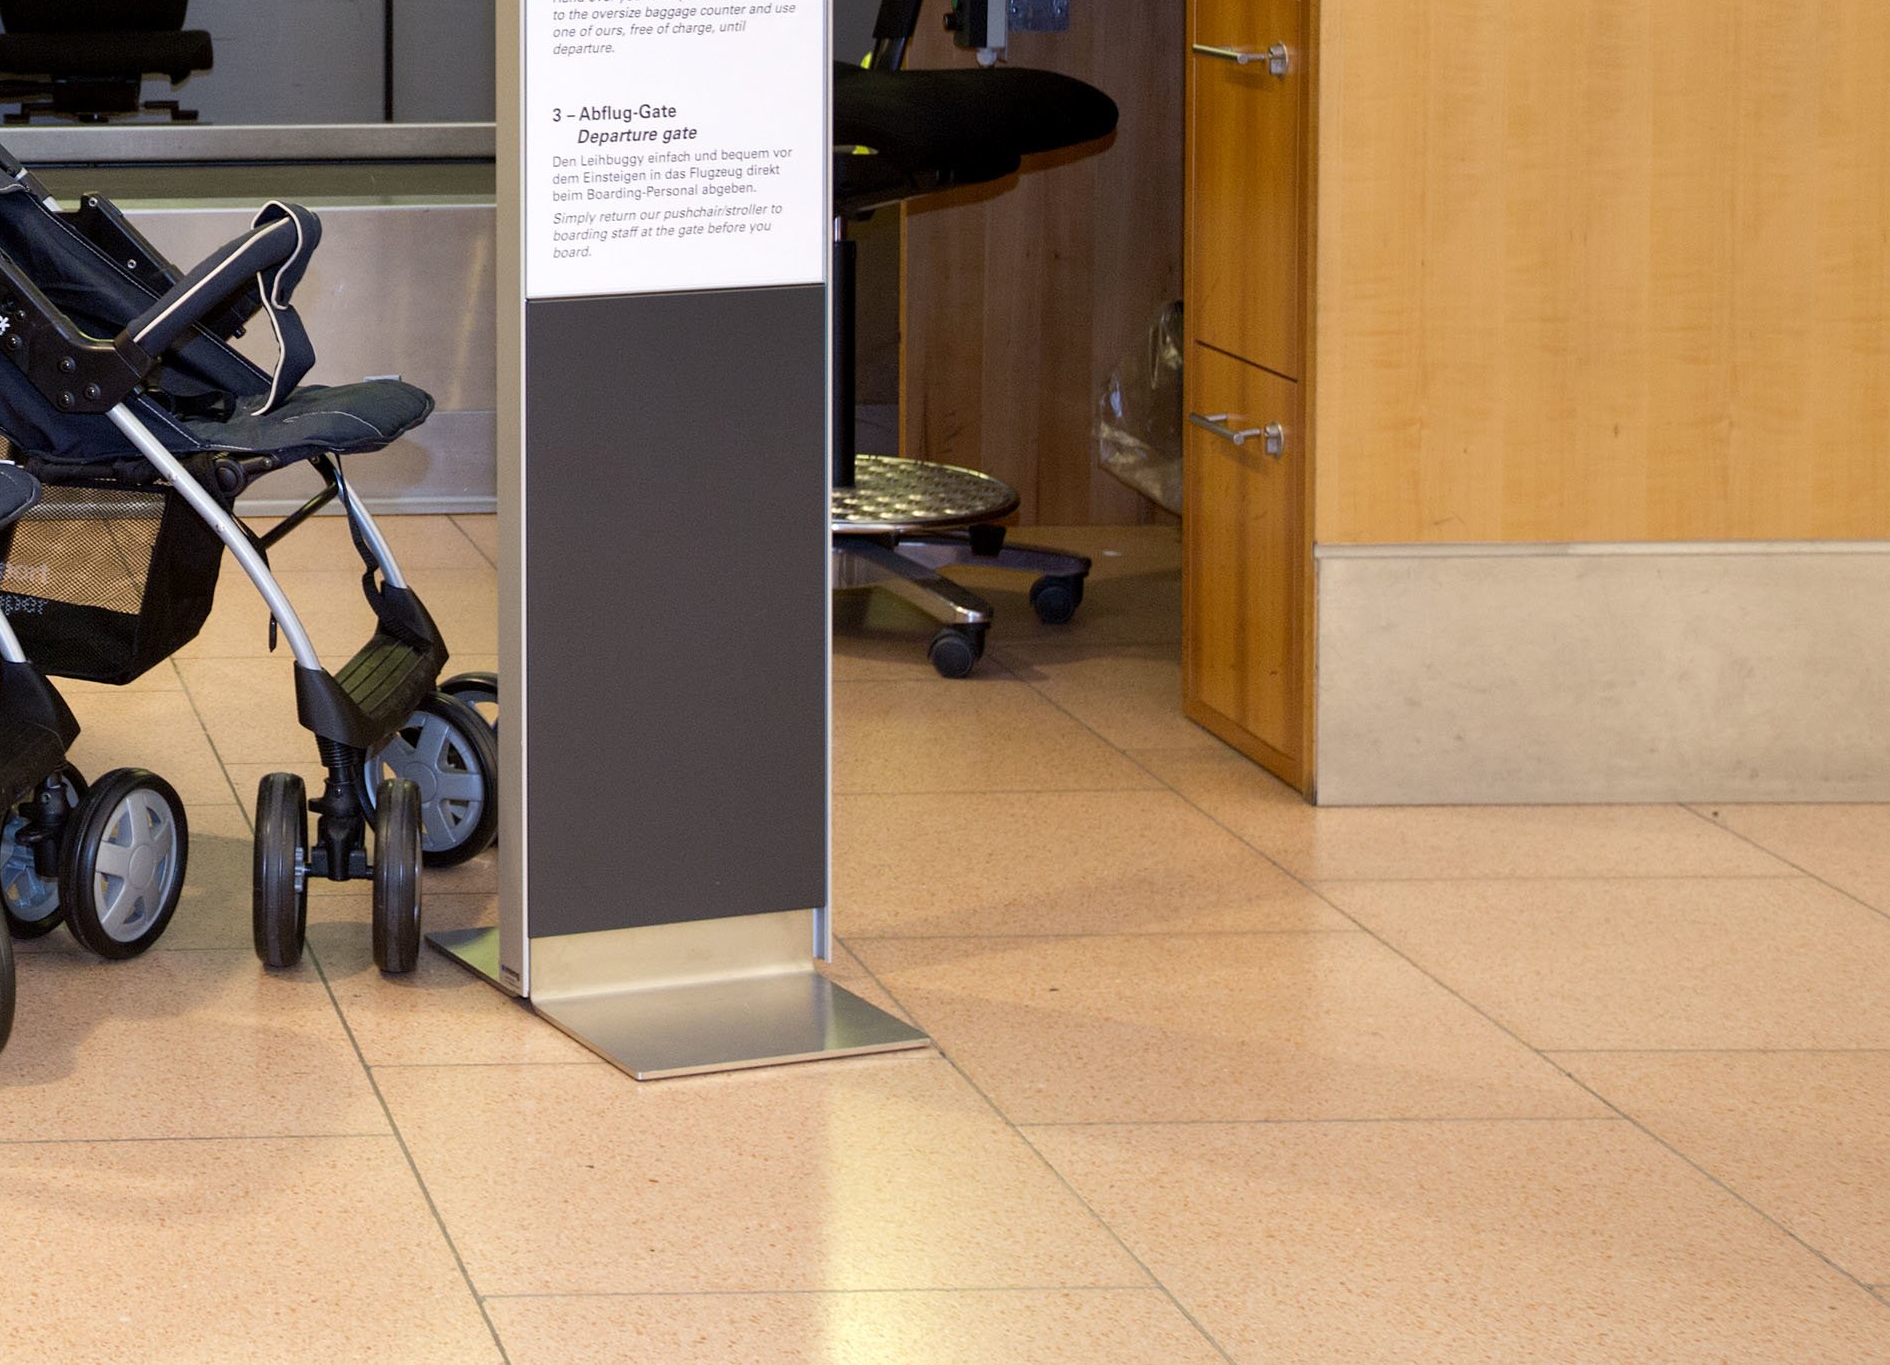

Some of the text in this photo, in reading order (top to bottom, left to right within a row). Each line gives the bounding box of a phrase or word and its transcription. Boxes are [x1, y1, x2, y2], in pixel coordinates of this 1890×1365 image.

[552, 2, 797, 21] to the oversize baggage counter and use
[552, 20, 747, 38] one of ours, free of charge, until
[552, 42, 615, 58] departure.
[552, 103, 677, 124] 3 Abflug-Gate
[577, 126, 698, 147] Departure gate
[552, 148, 793, 168] Den Leihbuggy einfach und bequem vor
[552, 163, 780, 185] dem Einsteigen in das Flugzeug direkt
[552, 182, 757, 202] beim Boarding-Personal abgeben.
[552, 203, 783, 226] Simply return our pushchair/stroller to
[552, 221, 772, 243] boarding staff at the gate before you
[552, 245, 592, 259] board.
